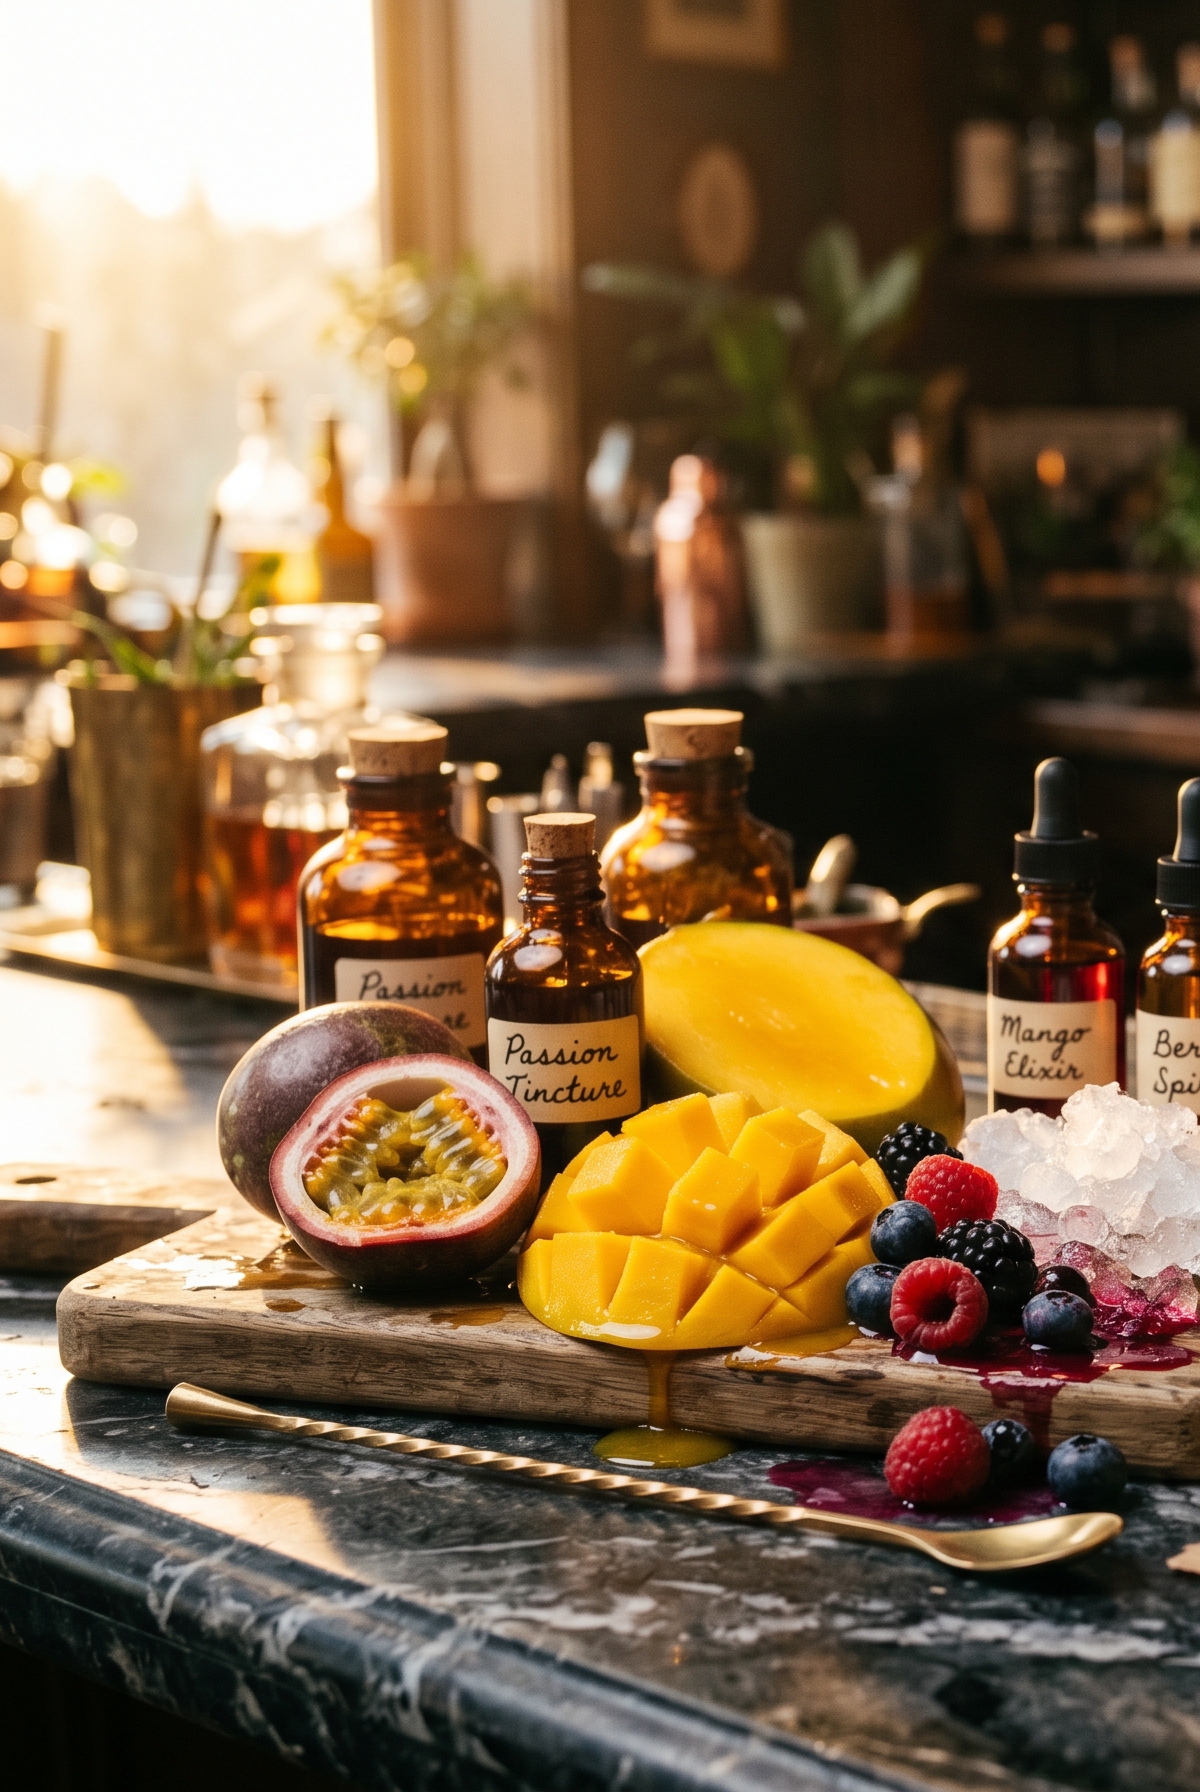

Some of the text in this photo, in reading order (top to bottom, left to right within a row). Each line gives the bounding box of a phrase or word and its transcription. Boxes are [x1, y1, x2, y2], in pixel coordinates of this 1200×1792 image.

[360, 970, 467, 1000] Passion
[505, 1033, 619, 1065] Passion
[1000, 1014, 1092, 1061] Mango
[1005, 1050, 1083, 1081] Elixir
[506, 1073, 627, 1104] Tincture
